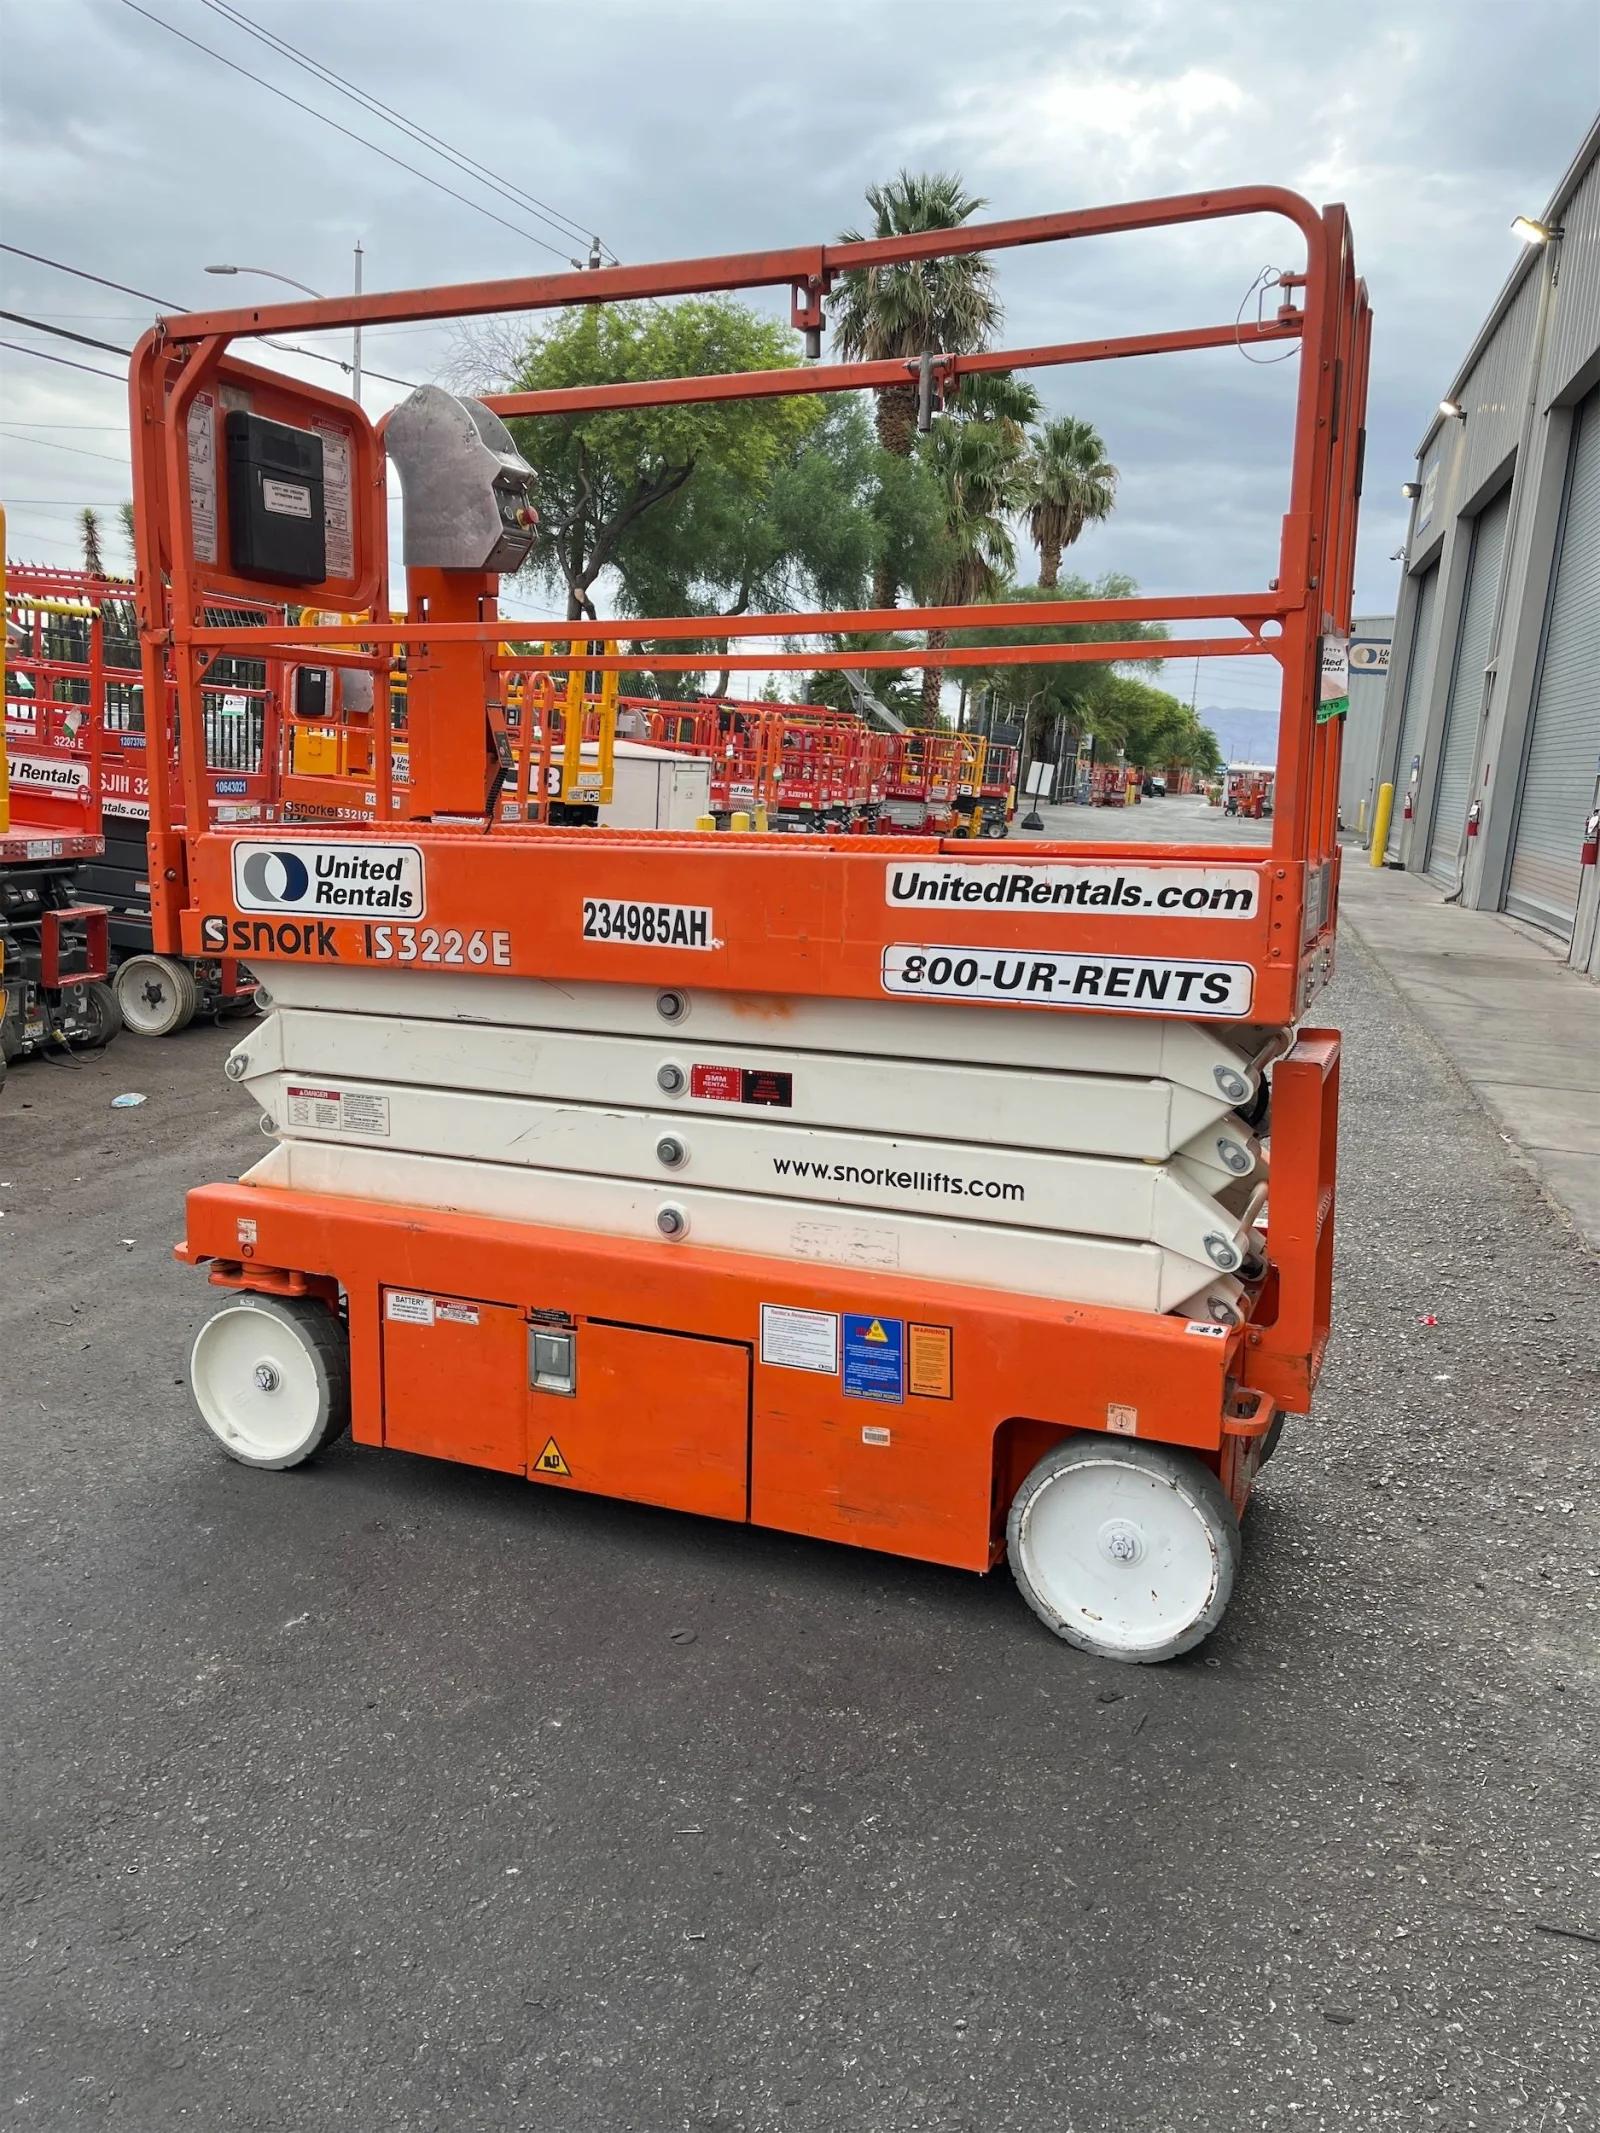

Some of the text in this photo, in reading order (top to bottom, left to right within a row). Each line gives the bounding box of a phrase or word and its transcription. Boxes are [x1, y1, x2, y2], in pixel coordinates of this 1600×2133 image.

[1322, 657, 1343, 666] ited
[77, 738, 84, 749] E
[20, 762, 81, 785] Rentals
[215, 780, 246, 793] 10643021
[583, 790, 600, 802] JCB
[315, 854, 404, 881] United
[315, 881, 413, 908] Rentals
[891, 871, 1253, 911] UnitedRentals.com
[583, 901, 707, 947] 234985AH
[901, 955, 1232, 1004] 800-UR-RENTS
[303, 1090, 328, 1099] DANGER
[773, 1158, 1025, 1201] www.snorkellifts.com
[395, 1295, 425, 1306] BATTERY
[913, 1326, 945, 1336] WARNING
